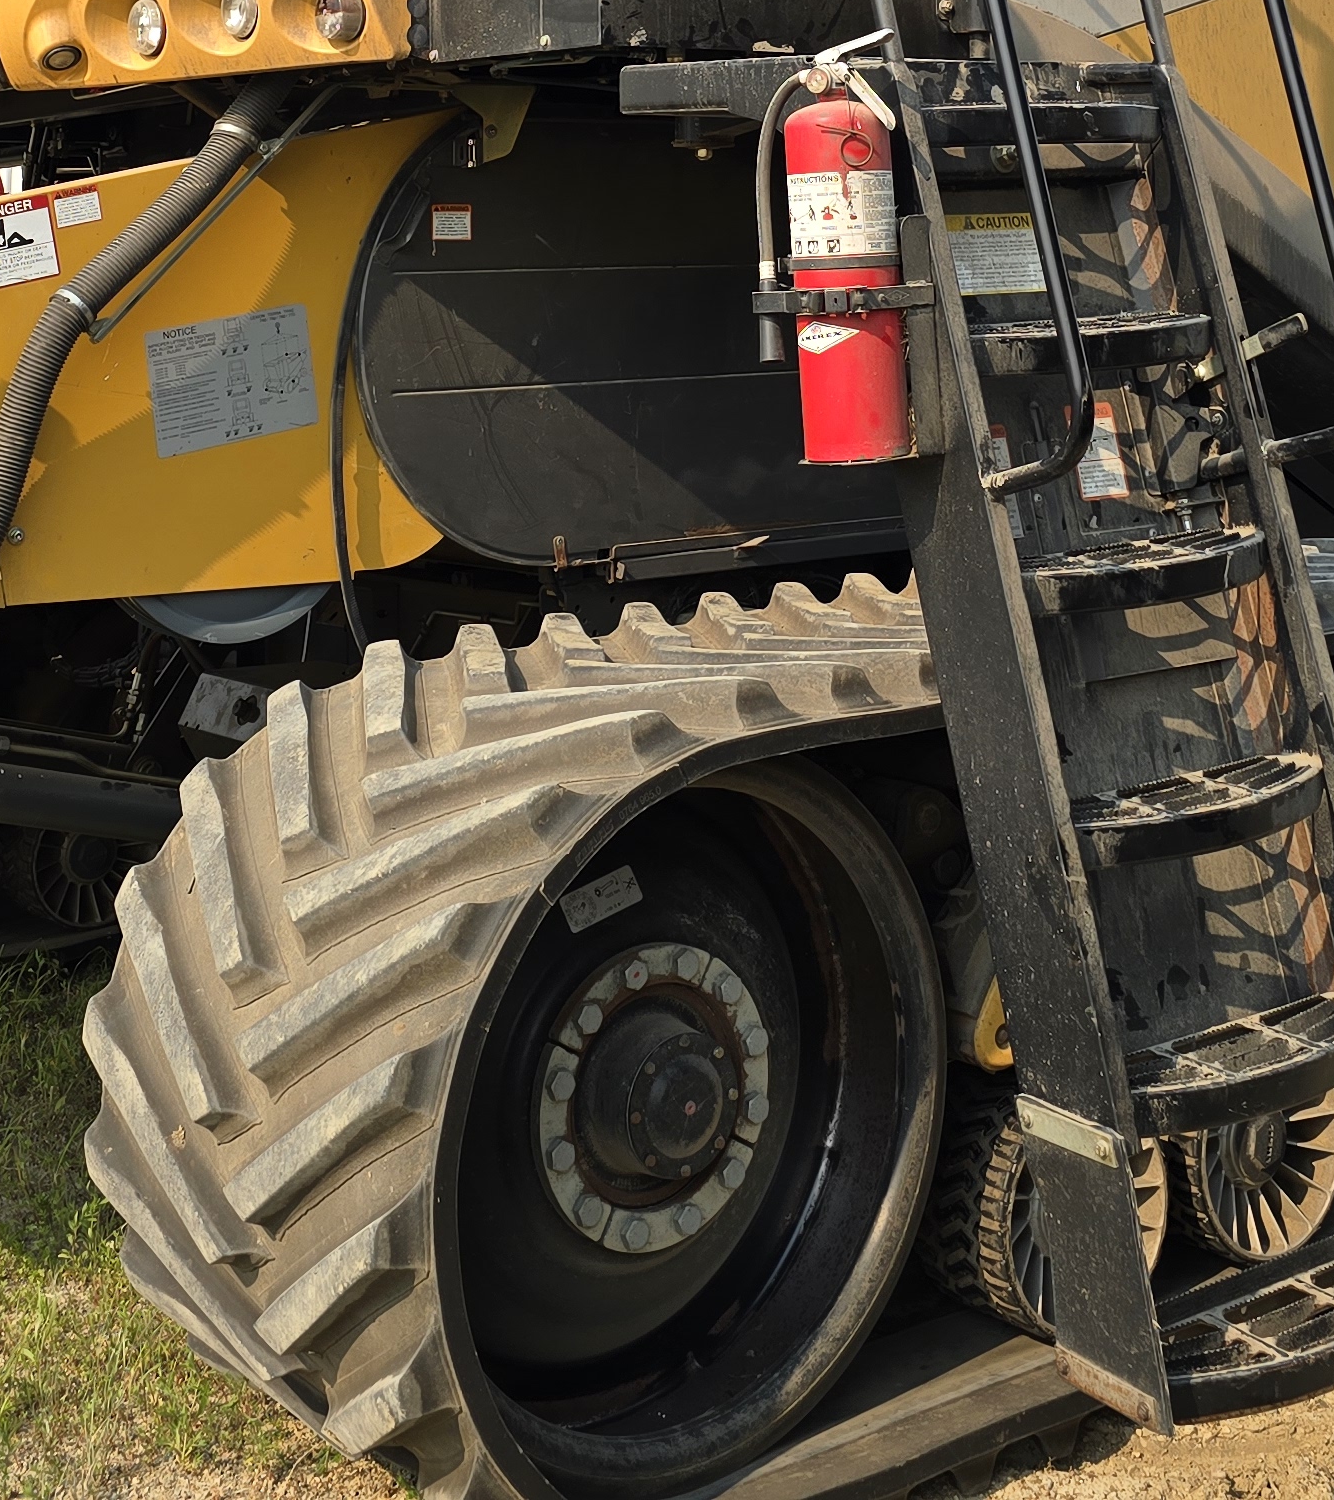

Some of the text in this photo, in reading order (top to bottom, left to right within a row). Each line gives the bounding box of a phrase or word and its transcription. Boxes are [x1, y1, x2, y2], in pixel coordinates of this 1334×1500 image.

[789, 174, 840, 185] NSTRUCTIONS
[975, 214, 1031, 230] CAUTION
[162, 325, 198, 340] NOTICE
